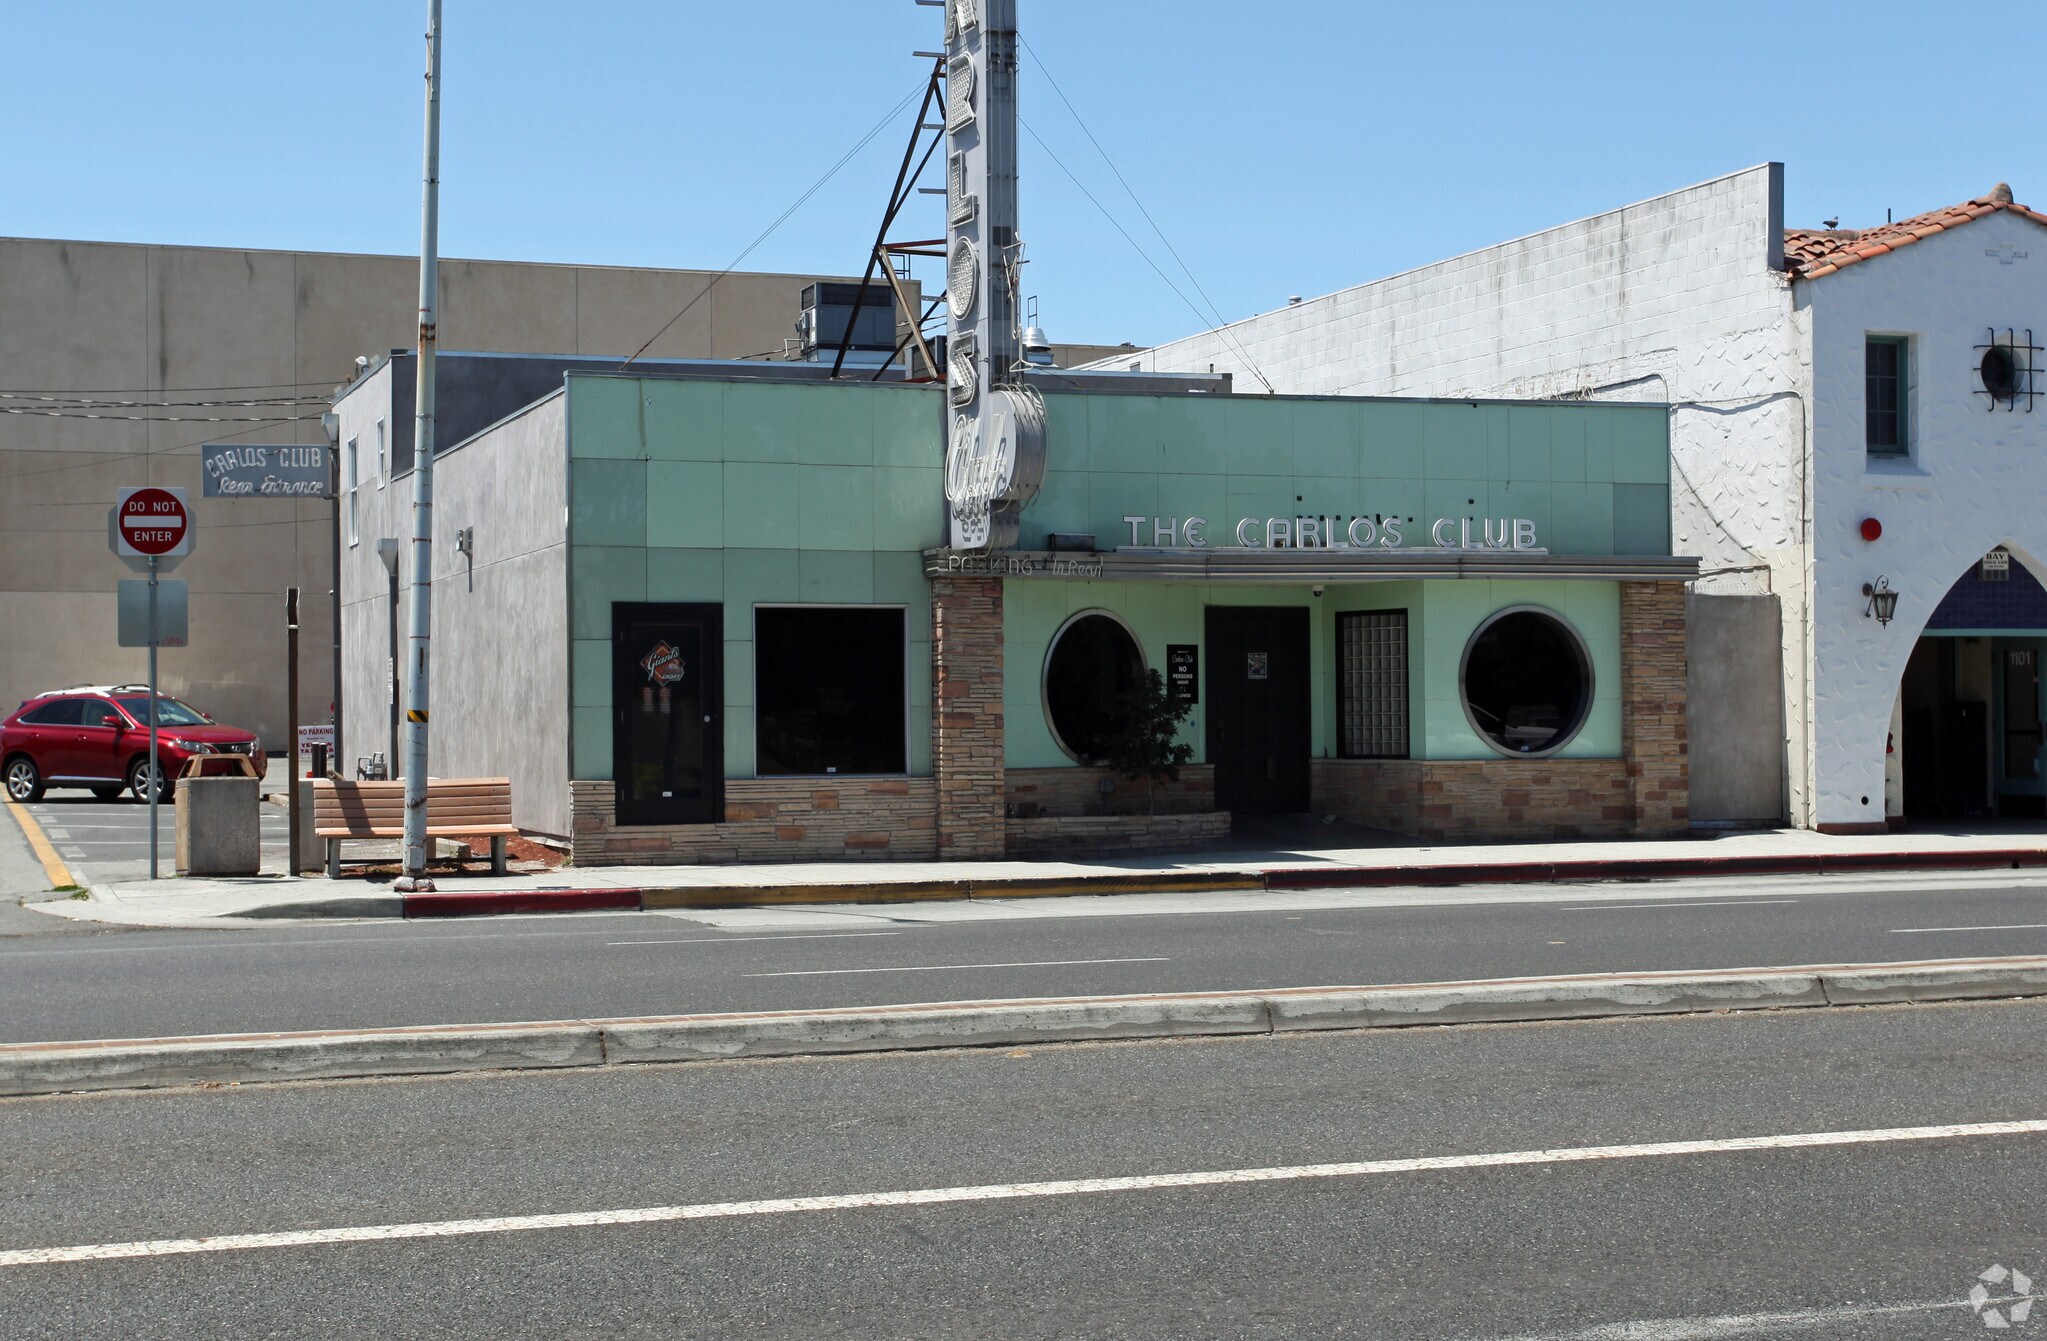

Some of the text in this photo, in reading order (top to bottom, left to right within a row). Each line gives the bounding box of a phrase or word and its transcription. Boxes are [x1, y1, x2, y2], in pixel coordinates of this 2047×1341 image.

[205, 447, 322, 478] CARLOS CLUB
[218, 474, 324, 495] Rear Entrance
[129, 501, 177, 513] DO NOT
[134, 531, 173, 542] ENTER
[1122, 515, 1538, 549] THE CARLOS CLUB
[948, 555, 1033, 576] PARKING
[647, 647, 679, 677] Giants
[2010, 650, 2031, 666] 1101
